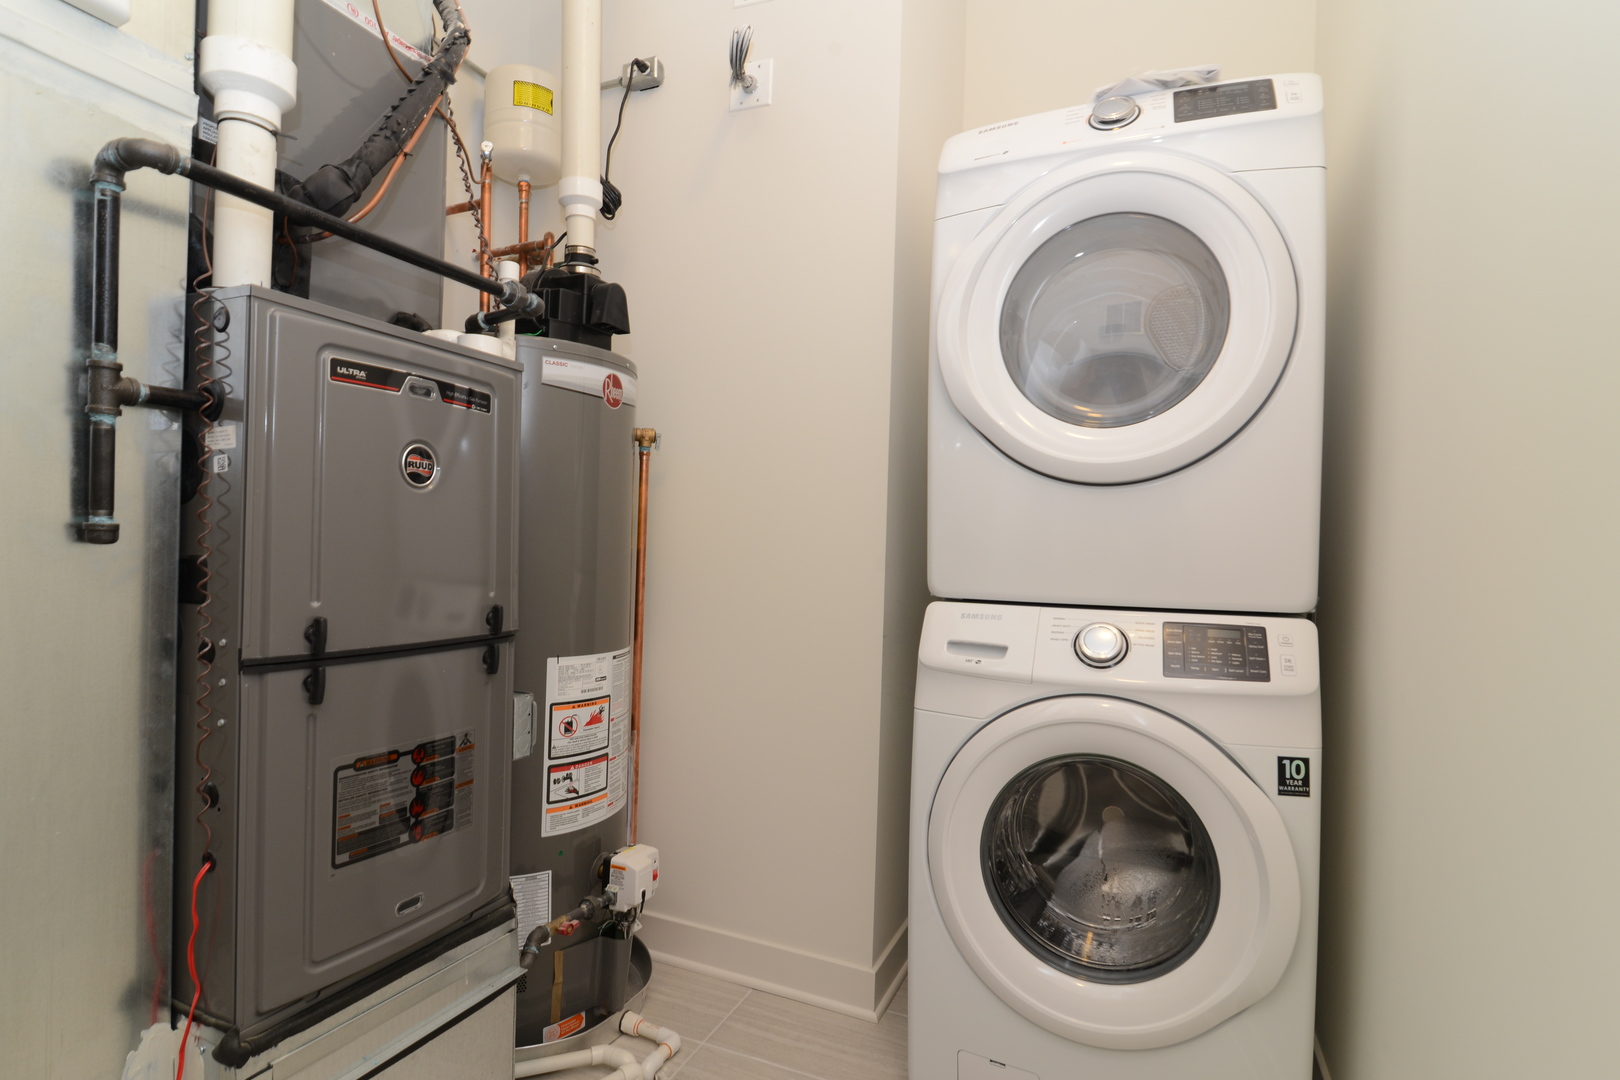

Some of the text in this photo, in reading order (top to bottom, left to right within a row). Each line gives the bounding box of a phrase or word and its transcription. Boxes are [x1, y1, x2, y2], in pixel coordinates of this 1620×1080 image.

[978, 121, 1020, 135] SAMSUNG
[544, 359, 569, 368] CLASSIC
[604, 373, 622, 403] Rheem
[408, 460, 433, 471] RUUD
[960, 612, 1003, 621] SAMSUNG
[575, 761, 593, 769] DANGER
[1281, 759, 1306, 780] 10
